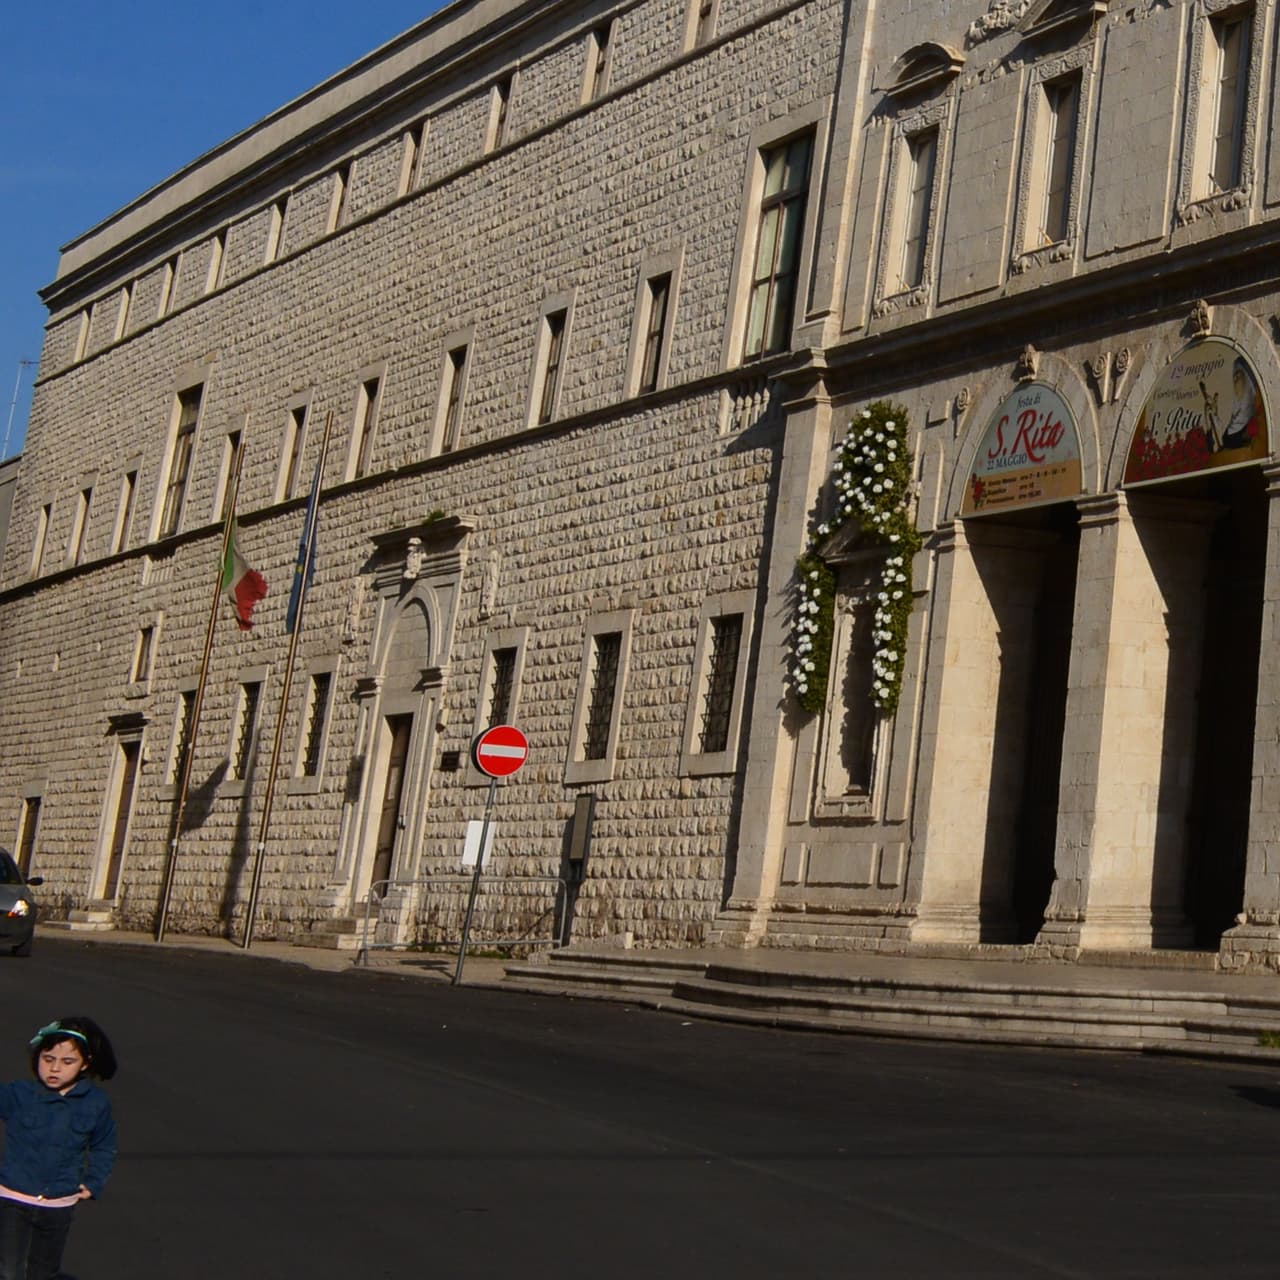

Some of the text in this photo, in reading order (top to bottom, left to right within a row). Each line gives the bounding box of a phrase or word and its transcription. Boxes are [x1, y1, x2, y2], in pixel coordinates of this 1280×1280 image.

[1165, 407, 1203, 433] Rita
[988, 408, 1066, 463] S. Rita
[995, 453, 1028, 469] MAGGIO
